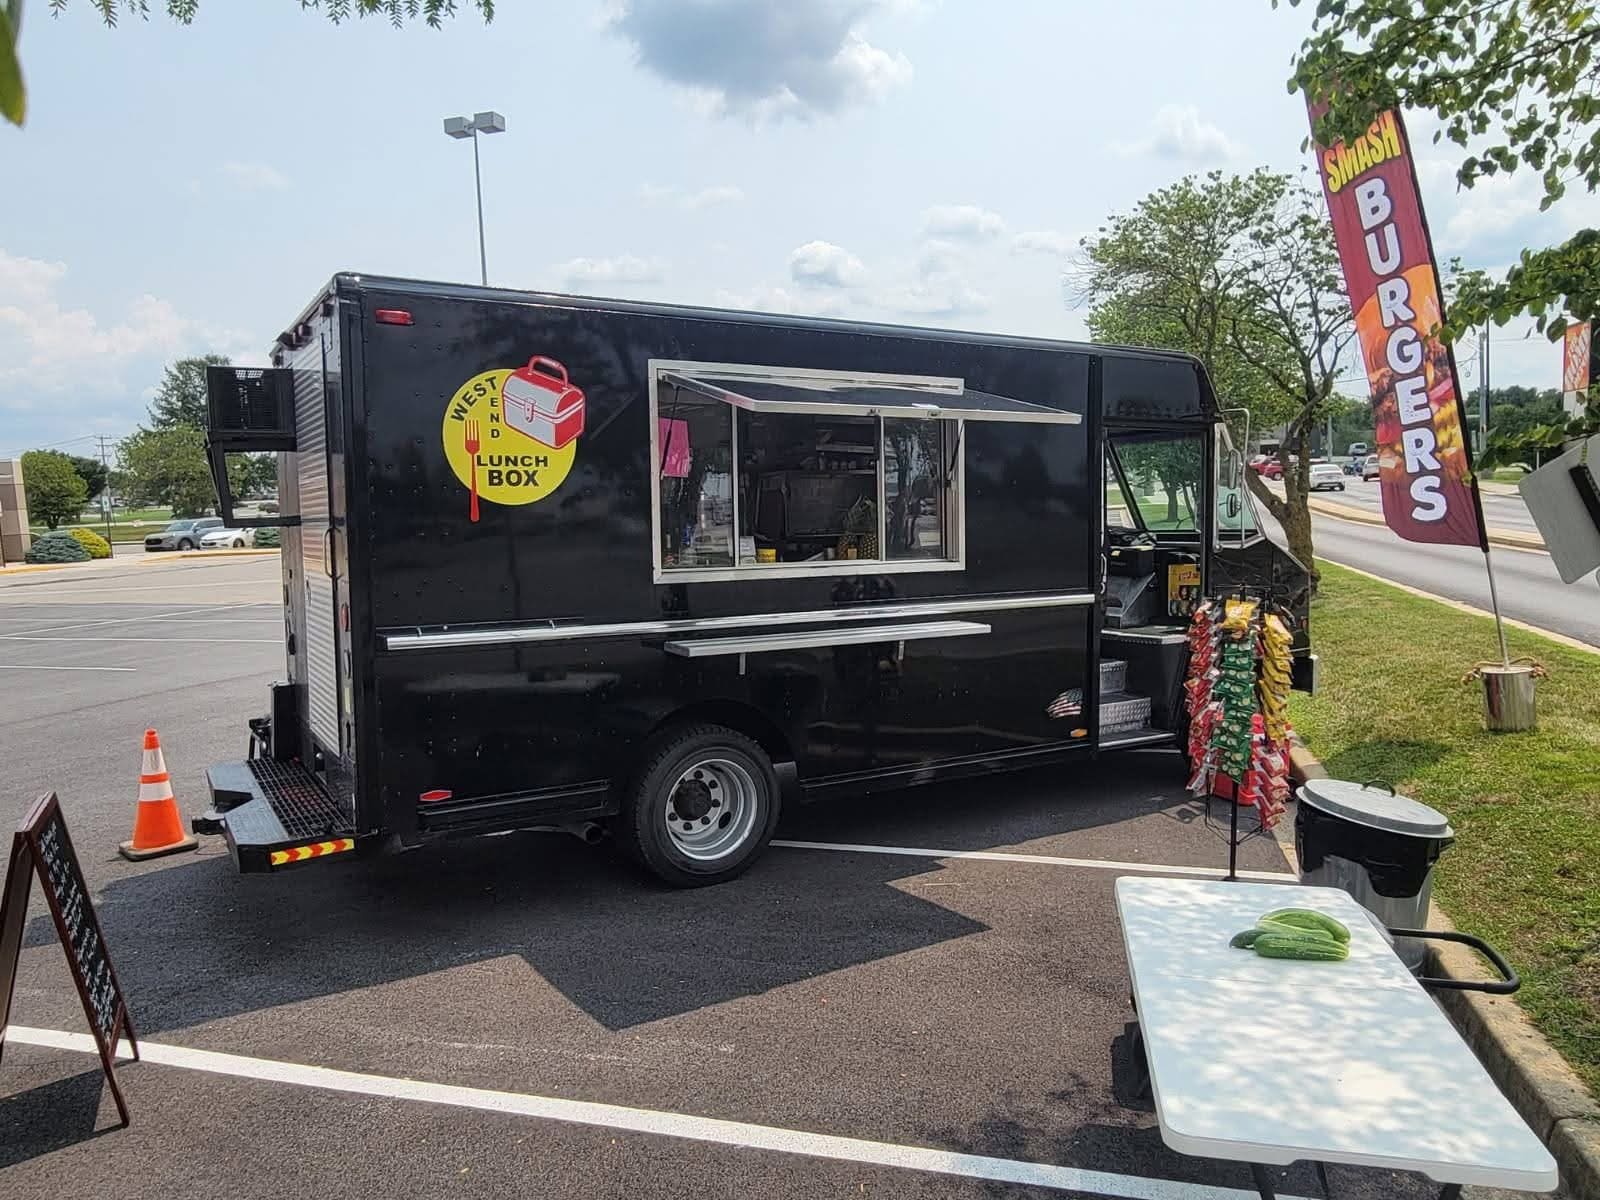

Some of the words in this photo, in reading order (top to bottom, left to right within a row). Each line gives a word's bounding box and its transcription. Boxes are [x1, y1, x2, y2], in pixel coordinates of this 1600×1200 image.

[1324, 109, 1401, 193] SMASH
[1355, 177, 1447, 521] BURGERS
[451, 376, 497, 422] WEST
[490, 397, 500, 439] END
[477, 455, 548, 467] LUNCH
[488, 470, 539, 487] BOX
